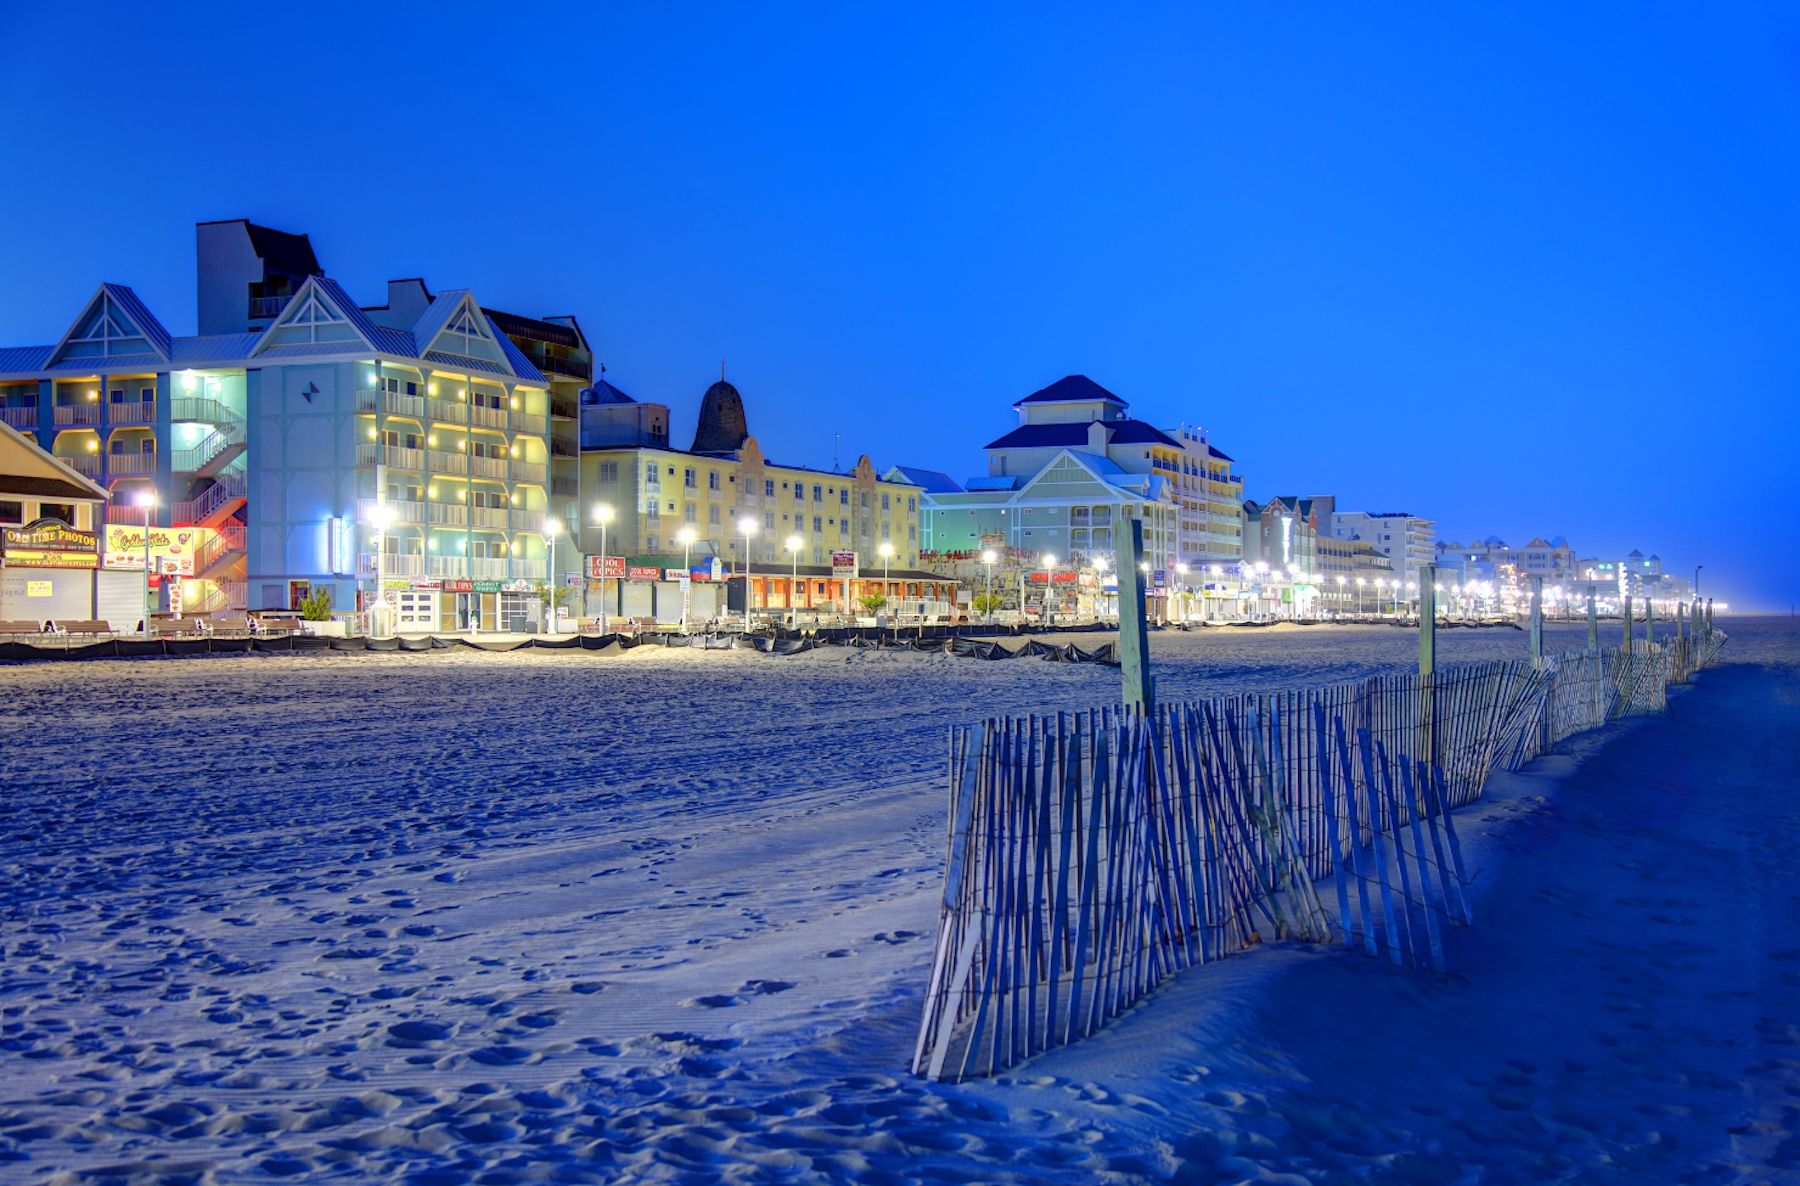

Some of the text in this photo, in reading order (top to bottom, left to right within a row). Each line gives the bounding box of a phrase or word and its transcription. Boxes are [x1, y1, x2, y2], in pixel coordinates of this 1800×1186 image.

[7, 530, 95, 545] OLD TIME PHOTOS
[596, 559, 619, 567] COOL
